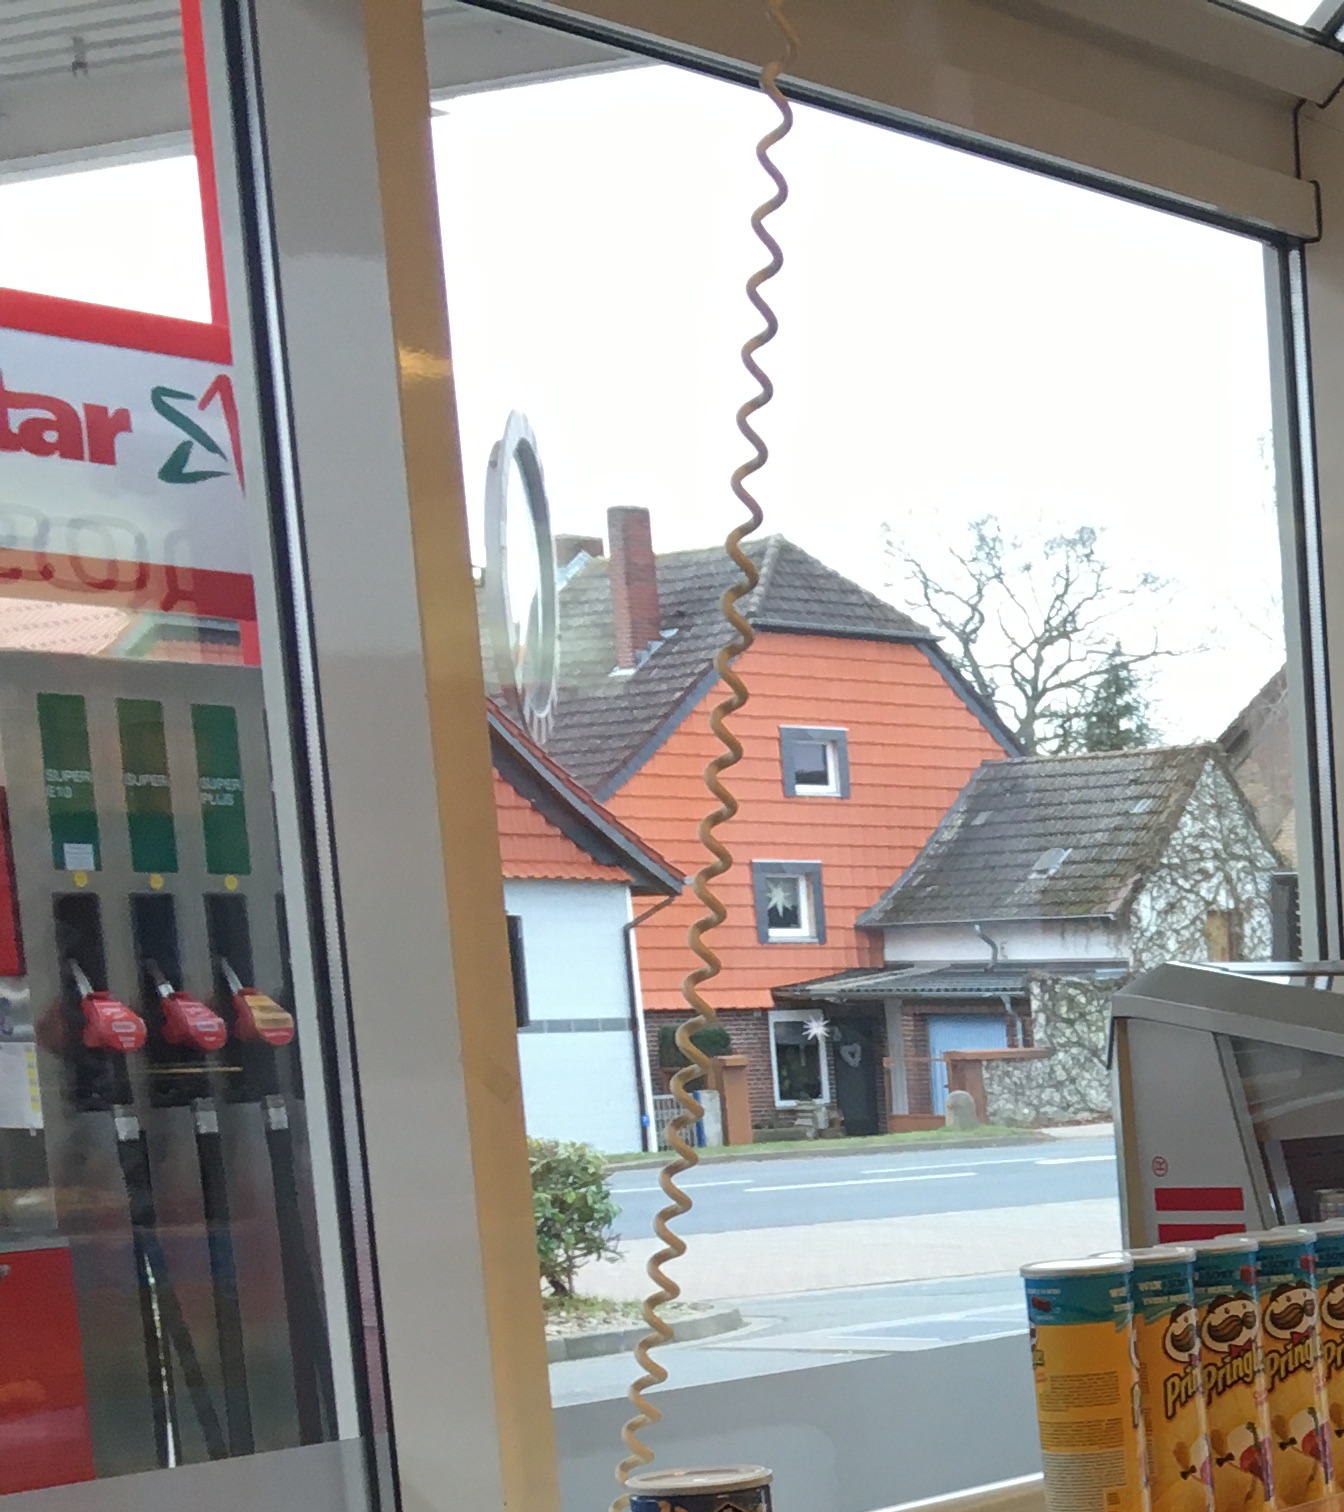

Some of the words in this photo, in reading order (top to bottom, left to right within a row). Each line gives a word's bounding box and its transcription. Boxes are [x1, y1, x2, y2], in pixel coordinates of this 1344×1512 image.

[0, 367, 132, 466] tar
[46, 769, 92, 783] SUPER
[124, 773, 171, 787] SUPER
[200, 777, 243, 790] SUPER
[201, 793, 235, 806] PLUS
[1264, 1338, 1316, 1392] Pring
[1202, 1346, 1266, 1406] Pringl
